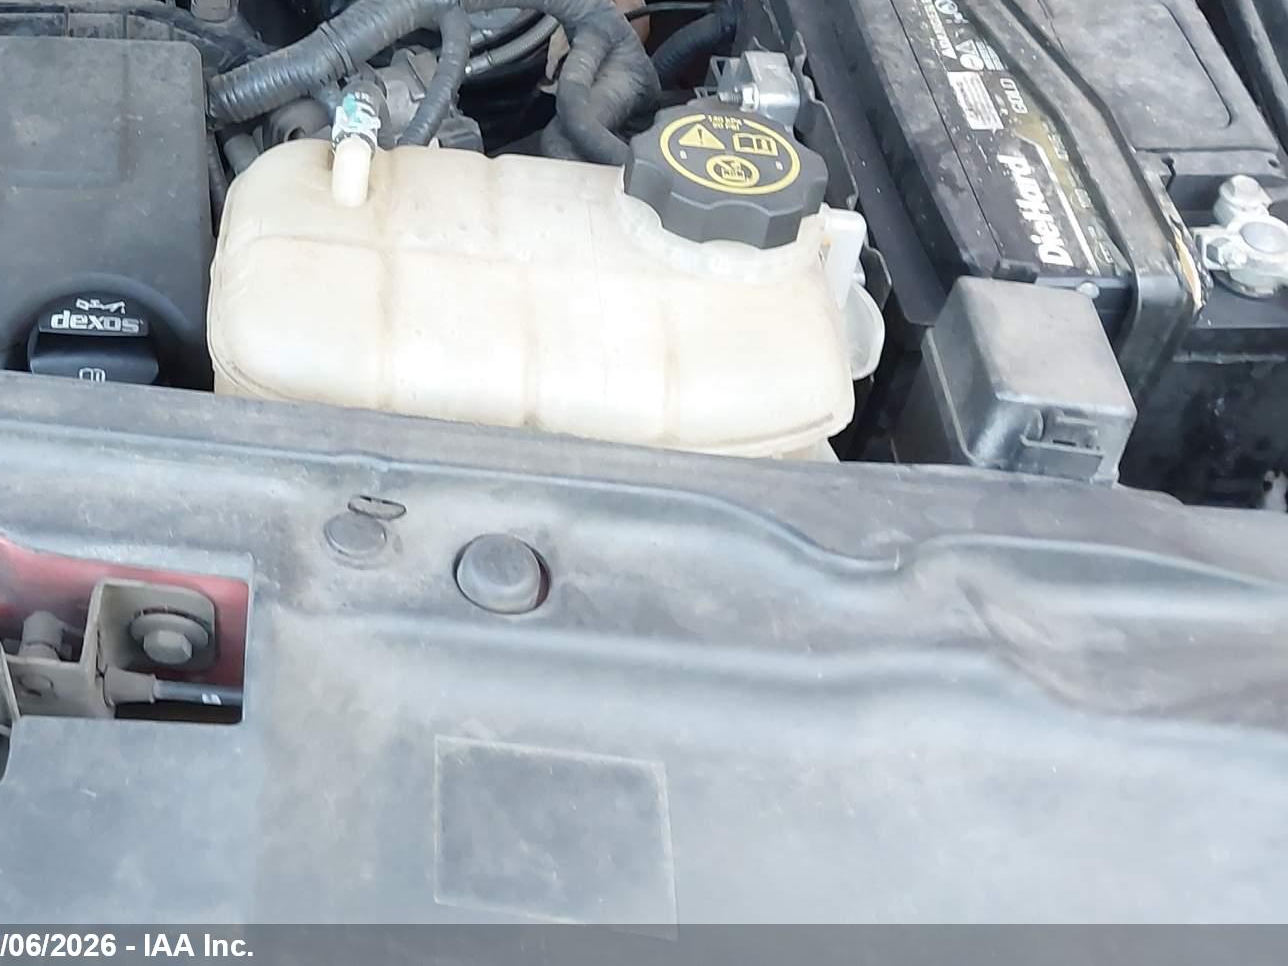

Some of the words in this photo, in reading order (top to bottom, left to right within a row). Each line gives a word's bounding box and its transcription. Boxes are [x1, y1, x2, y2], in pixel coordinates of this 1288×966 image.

[1000, 78, 1029, 115] GOLD
[997, 154, 1075, 267] DieHard
[50, 309, 140, 334] dexos
